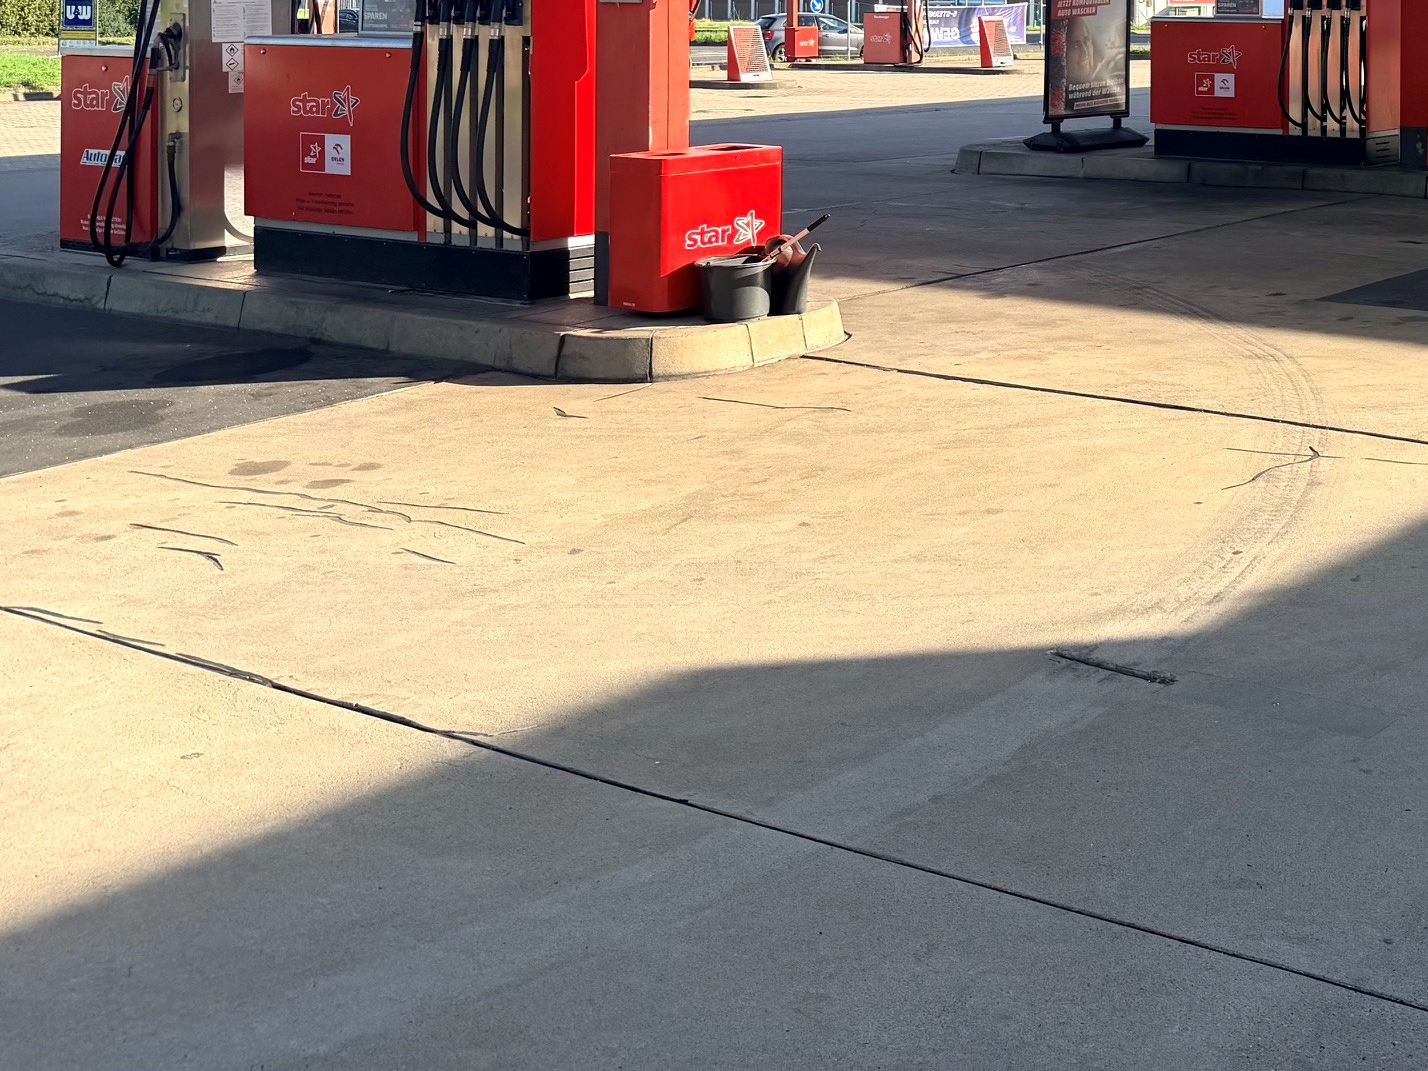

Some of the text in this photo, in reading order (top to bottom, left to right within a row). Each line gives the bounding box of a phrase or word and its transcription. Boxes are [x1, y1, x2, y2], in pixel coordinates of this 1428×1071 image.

[1056, 0, 1071, 8] JETZT
[1057, 6, 1096, 17] AUTO WASCHEN
[1187, 48, 1220, 64] star
[71, 83, 109, 111] star
[290, 91, 331, 117] star
[84, 149, 124, 164] Autoa
[685, 223, 731, 250] star
